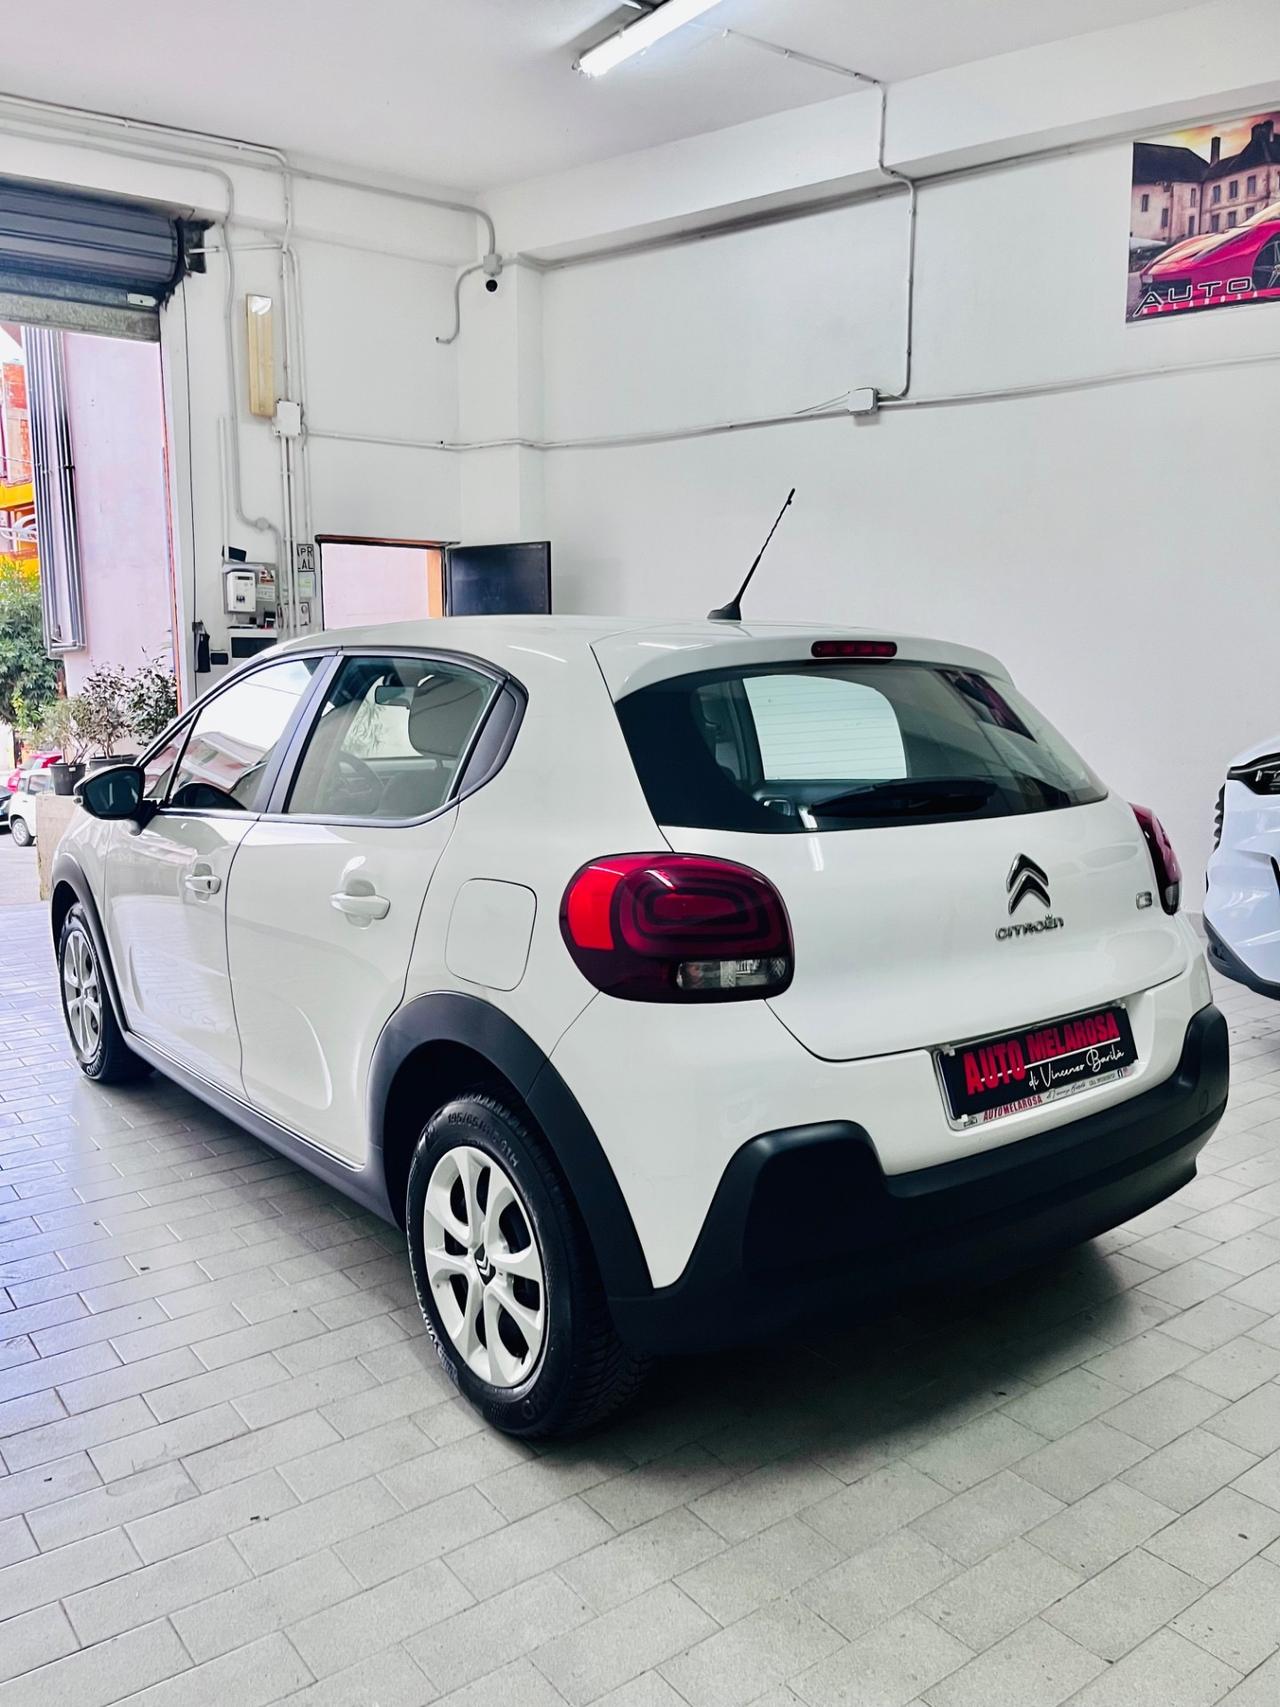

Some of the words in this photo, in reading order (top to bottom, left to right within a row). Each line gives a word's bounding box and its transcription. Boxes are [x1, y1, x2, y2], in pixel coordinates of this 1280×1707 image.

[1133, 276, 1253, 318] AUTO
[962, 1039, 1027, 1096] AUTO
[1025, 1012, 1120, 1062] MELAROSA
[983, 1096, 1043, 1121] AUTOMELAROSA
